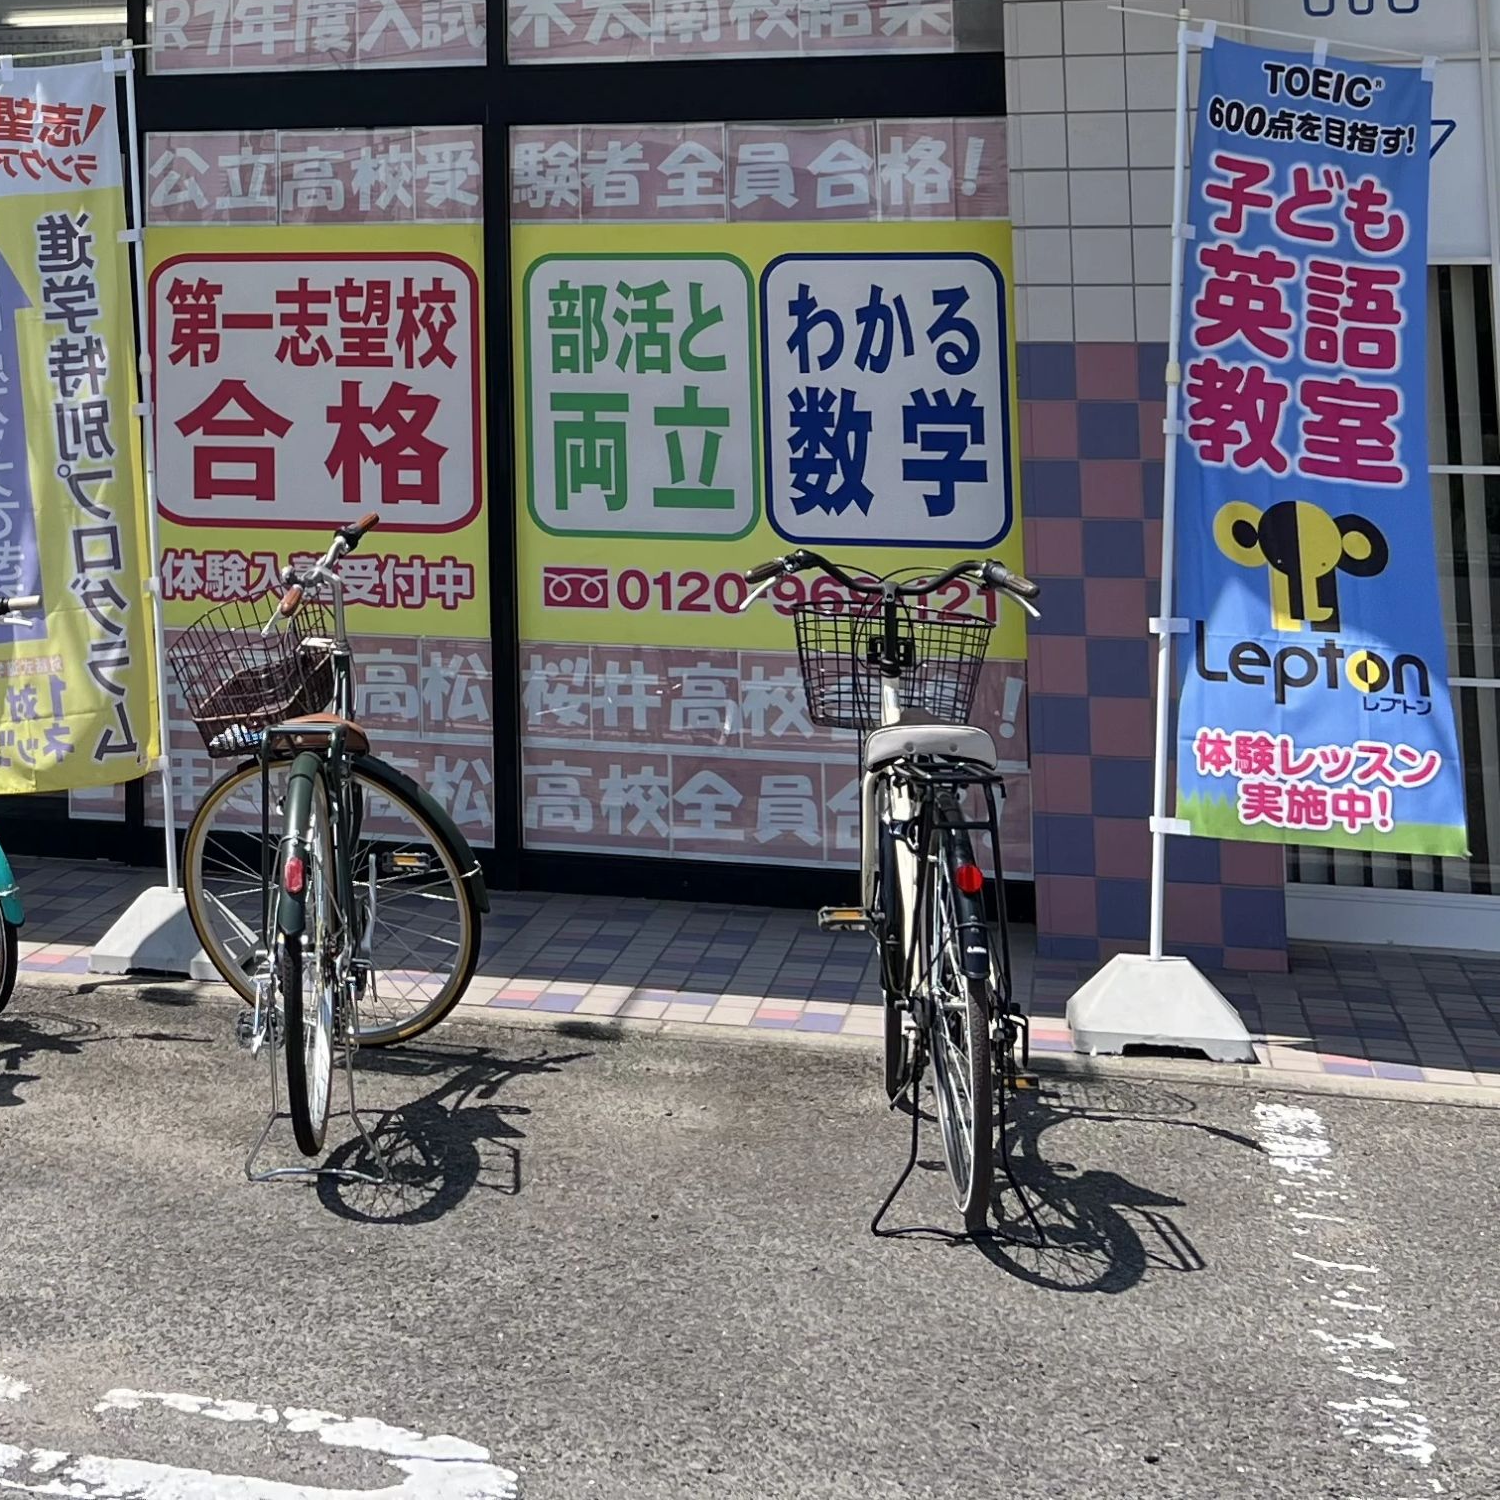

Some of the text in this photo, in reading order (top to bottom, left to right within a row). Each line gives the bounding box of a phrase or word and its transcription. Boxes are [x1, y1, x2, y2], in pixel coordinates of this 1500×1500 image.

[1205, 155, 1405, 253] 子ども
[166, 277, 457, 368] 第一志望校
[548, 279, 729, 374] 部活と
[788, 283, 982, 376] わかる
[1194, 244, 1400, 369] 英語
[175, 379, 450, 506] 合格
[550, 386, 736, 511] 両立
[788, 386, 989, 518] 数学
[1188, 360, 1405, 484] 教室
[1194, 619, 1431, 705] Lepton
[1363, 695, 1433, 716] レプトン
[1195, 733, 1442, 789] 体験レッスン
